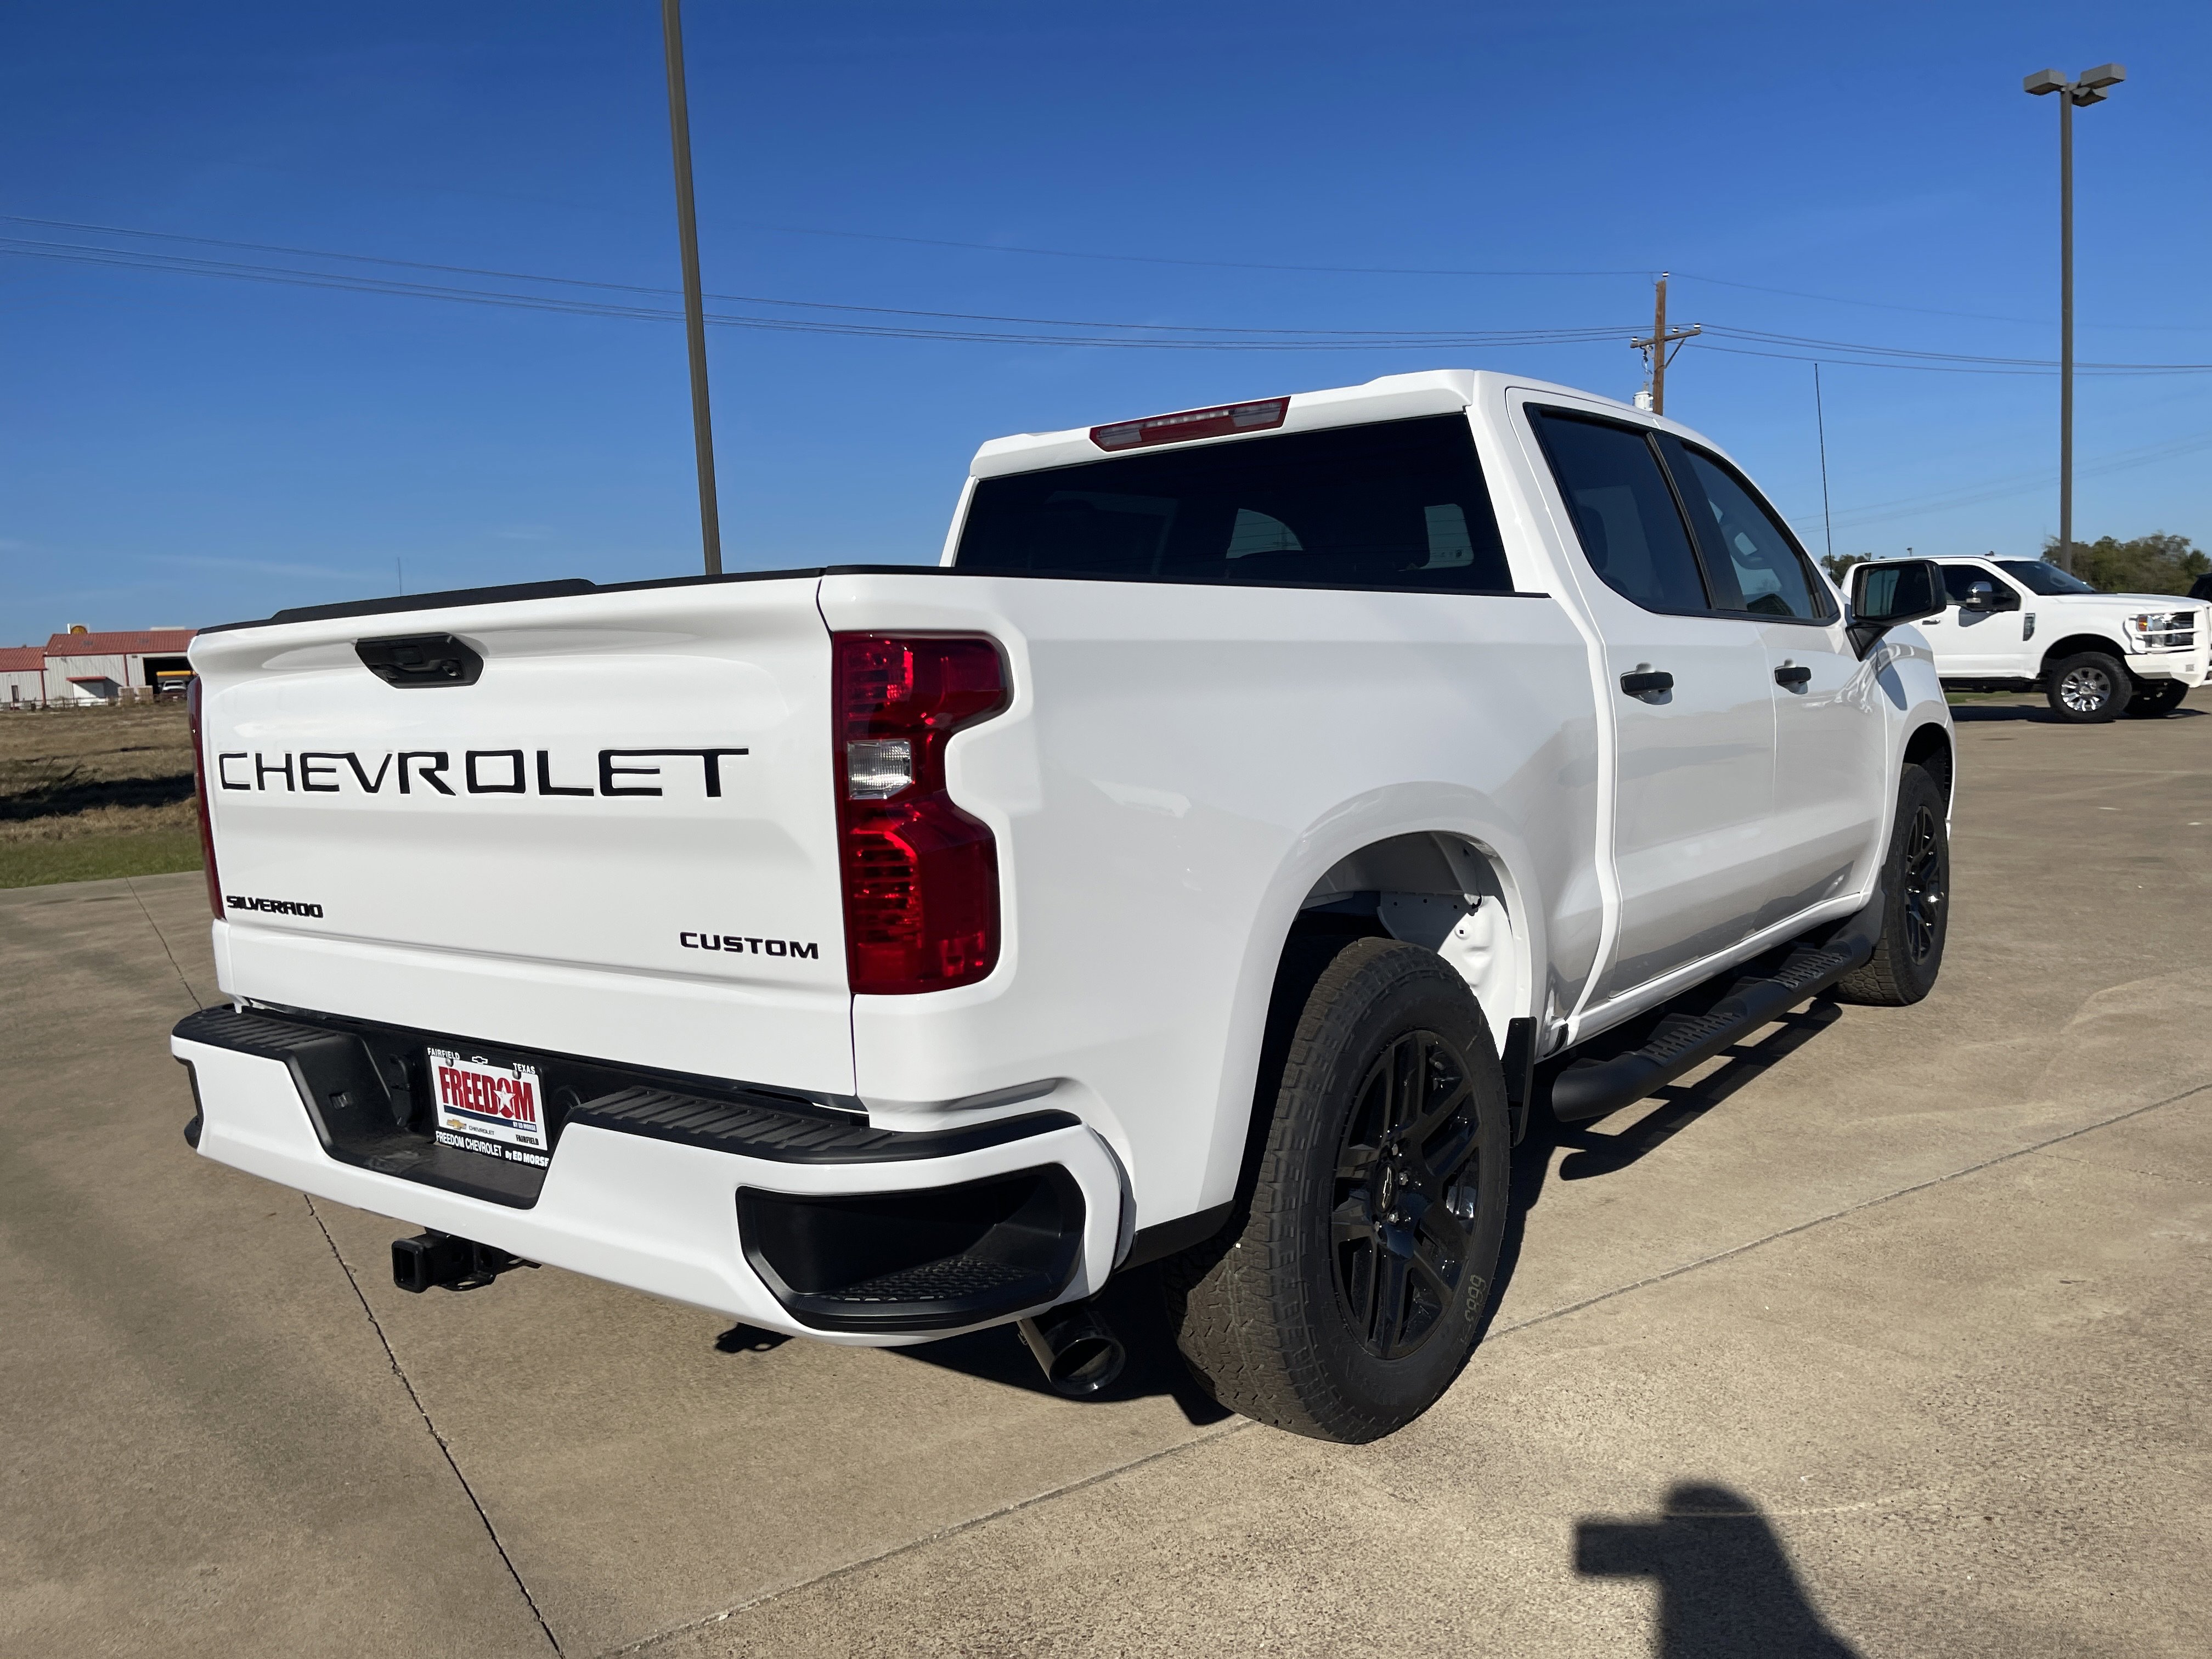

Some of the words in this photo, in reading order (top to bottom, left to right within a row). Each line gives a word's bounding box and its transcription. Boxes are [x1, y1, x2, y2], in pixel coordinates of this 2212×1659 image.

[219, 747, 749, 798] CHEVROLET
[226, 895, 324, 919] SILVERADO
[680, 931, 819, 960] CUSTOM
[427, 1047, 460, 1060] FAIRFIELD
[512, 1062, 536, 1074] TEXAS
[438, 1065, 536, 1122] FREEDOM
[469, 1125, 495, 1135] CHEVROLET
[515, 1134, 539, 1146] FAIRFIELD
[435, 1130, 465, 1148] FREEDOM
[465, 1137, 502, 1157] CHEVROLET
[512, 1150, 522, 1161] ED
